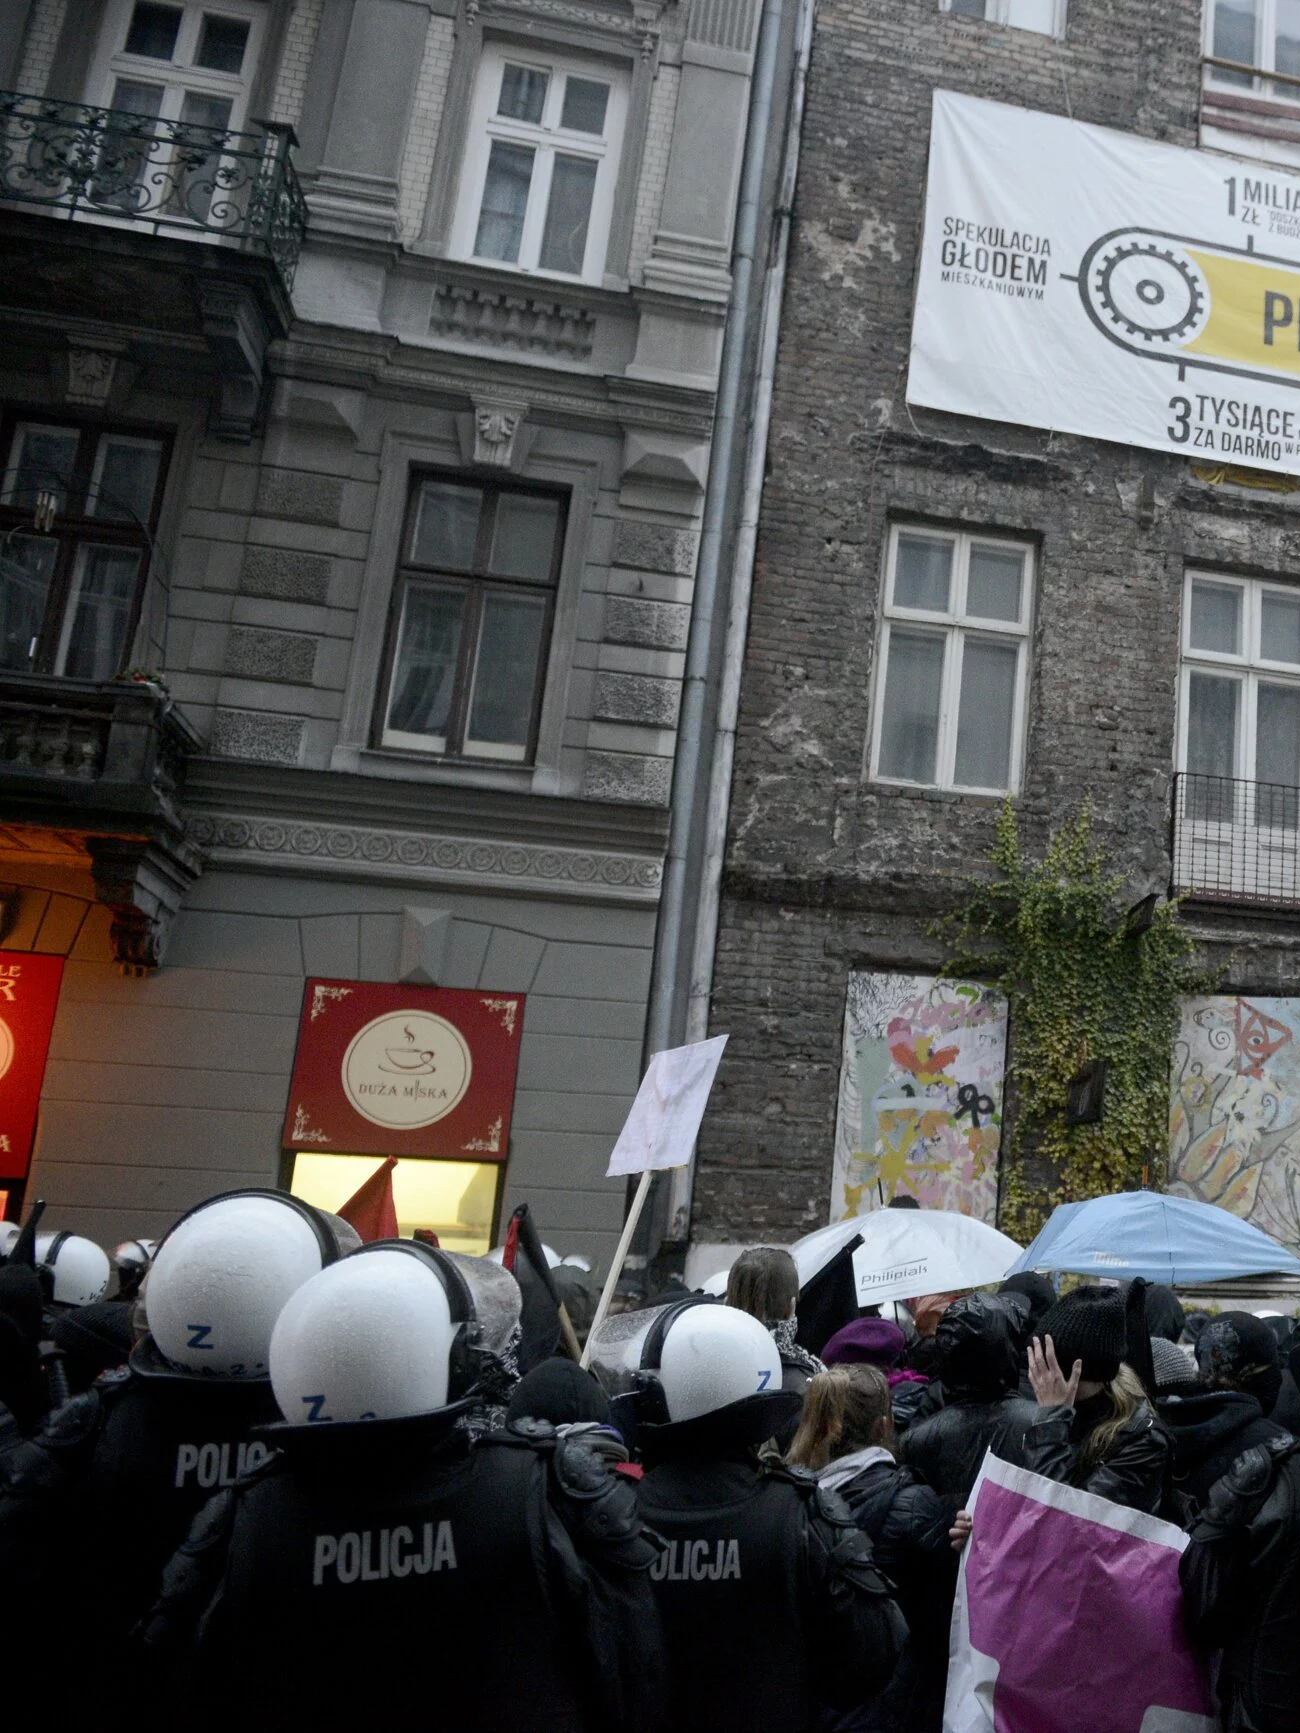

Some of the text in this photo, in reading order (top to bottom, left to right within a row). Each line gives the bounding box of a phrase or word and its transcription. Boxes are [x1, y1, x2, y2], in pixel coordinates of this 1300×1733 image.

[1224, 176, 1236, 216] 1
[1241, 205, 1261, 226] ZŁ
[943, 217, 1051, 257] SPEKULACJA
[941, 239, 1047, 286] GŁODEM
[941, 271, 1044, 300] MIESZKANIOWYM
[1168, 396, 1192, 443] 3
[1196, 394, 1295, 439] TYSIĄCE
[1193, 427, 1215, 449] ZA
[1221, 433, 1281, 461] DARMO
[1285, 442, 1294, 454] W
[358, 1083, 397, 1097] DUŻA
[187, 1325, 214, 1350] Z
[757, 1370, 771, 1391] Z
[301, 1394, 332, 1421] Z
[175, 1441, 268, 1488] POLIC
[313, 1520, 458, 1586] POLICJA
[649, 1538, 742, 1581] OLICJA
